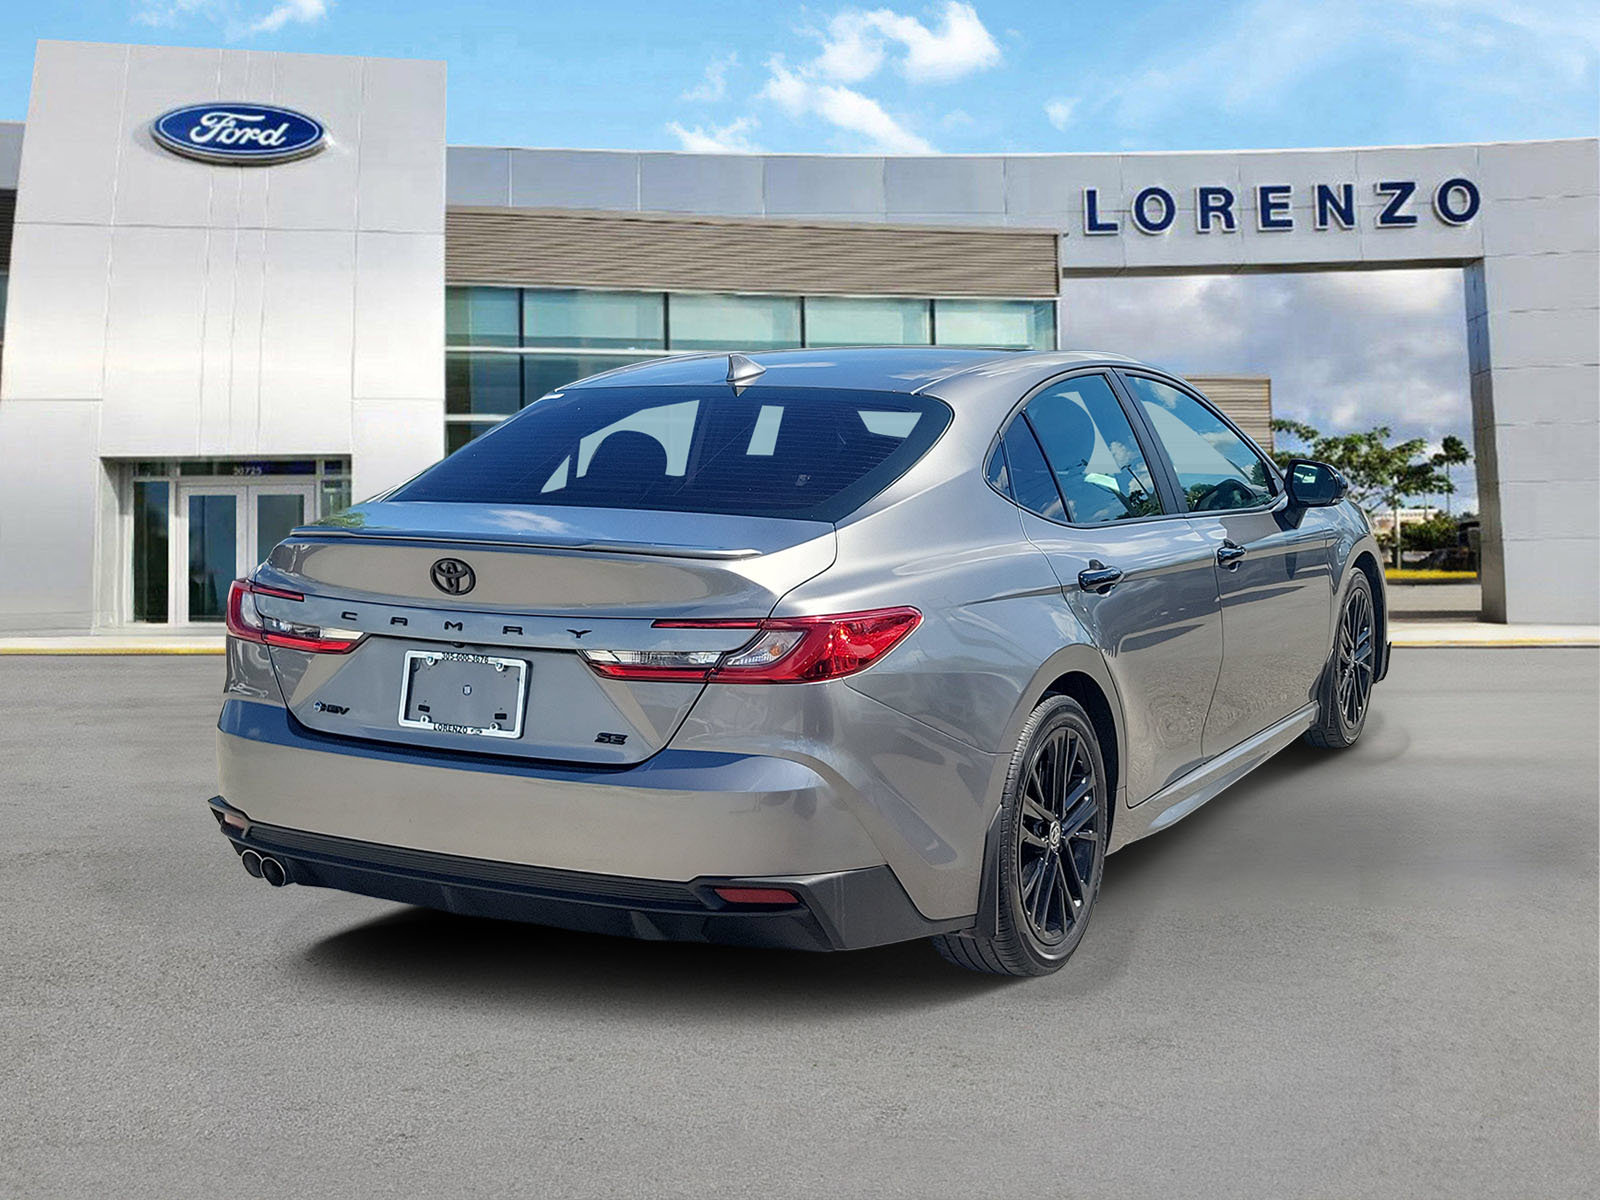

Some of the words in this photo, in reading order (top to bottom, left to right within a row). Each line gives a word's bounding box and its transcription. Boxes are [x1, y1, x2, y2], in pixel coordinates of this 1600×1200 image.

[190, 112, 290, 146] Ford
[1084, 177, 1481, 234] LORENZO
[341, 611, 593, 638] CAMRY
[433, 723, 468, 734] LORENZO
